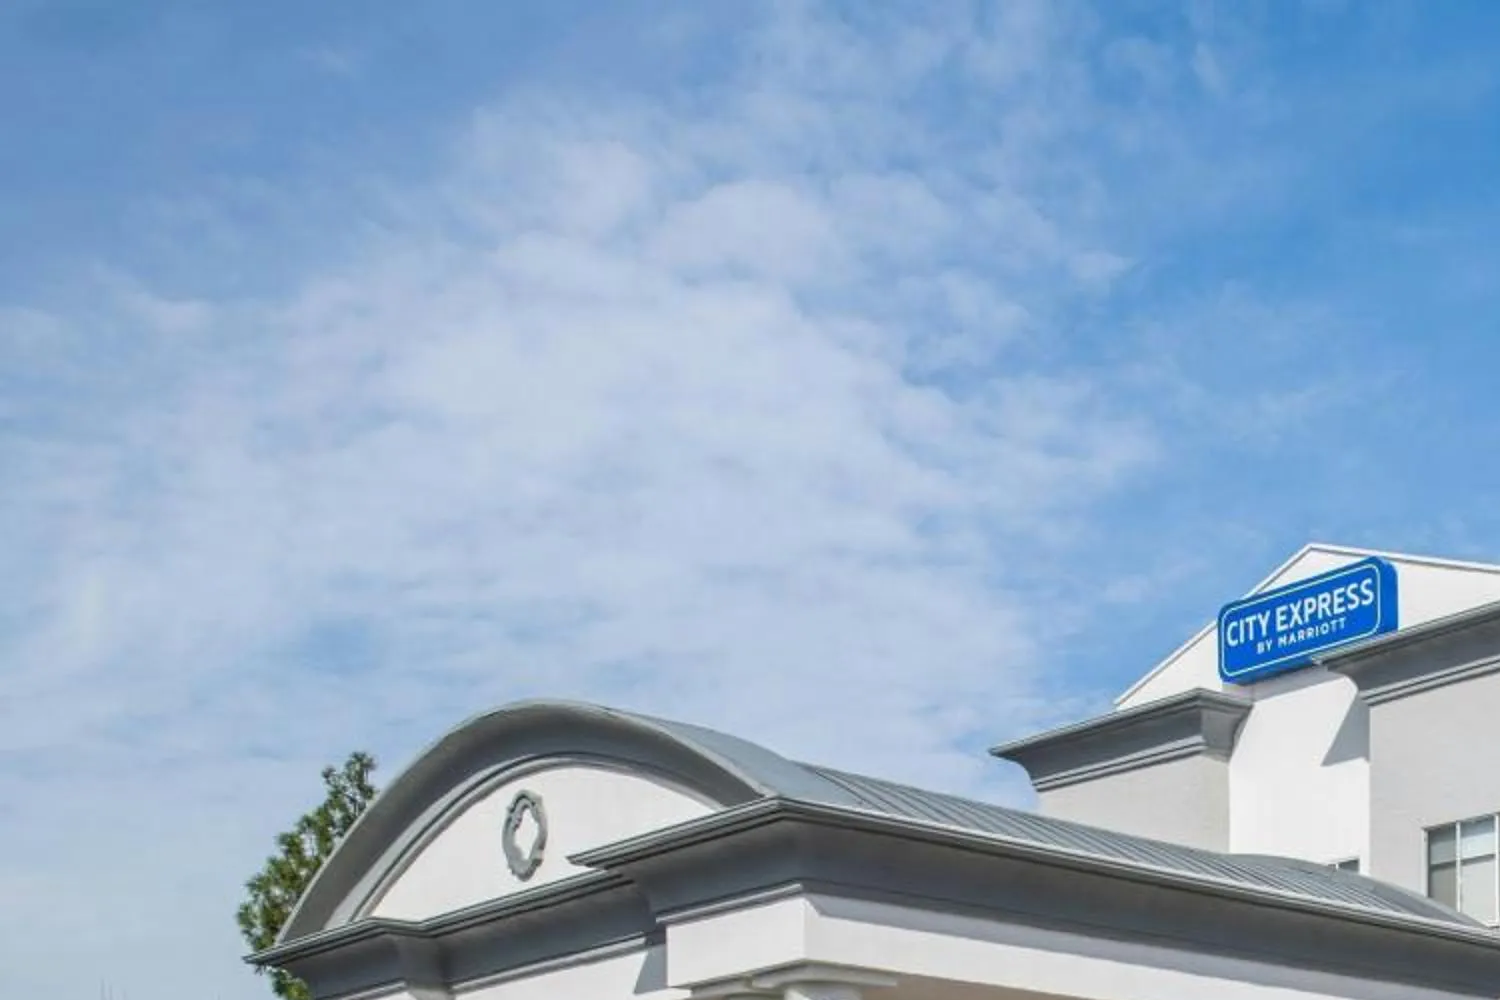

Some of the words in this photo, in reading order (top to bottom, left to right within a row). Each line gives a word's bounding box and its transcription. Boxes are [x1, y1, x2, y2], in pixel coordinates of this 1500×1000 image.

[1226, 608, 1271, 647] CITY
[1275, 578, 1375, 632] EXPRESS
[1256, 639, 1273, 655] BY
[1277, 617, 1347, 648] MARRIOTT
